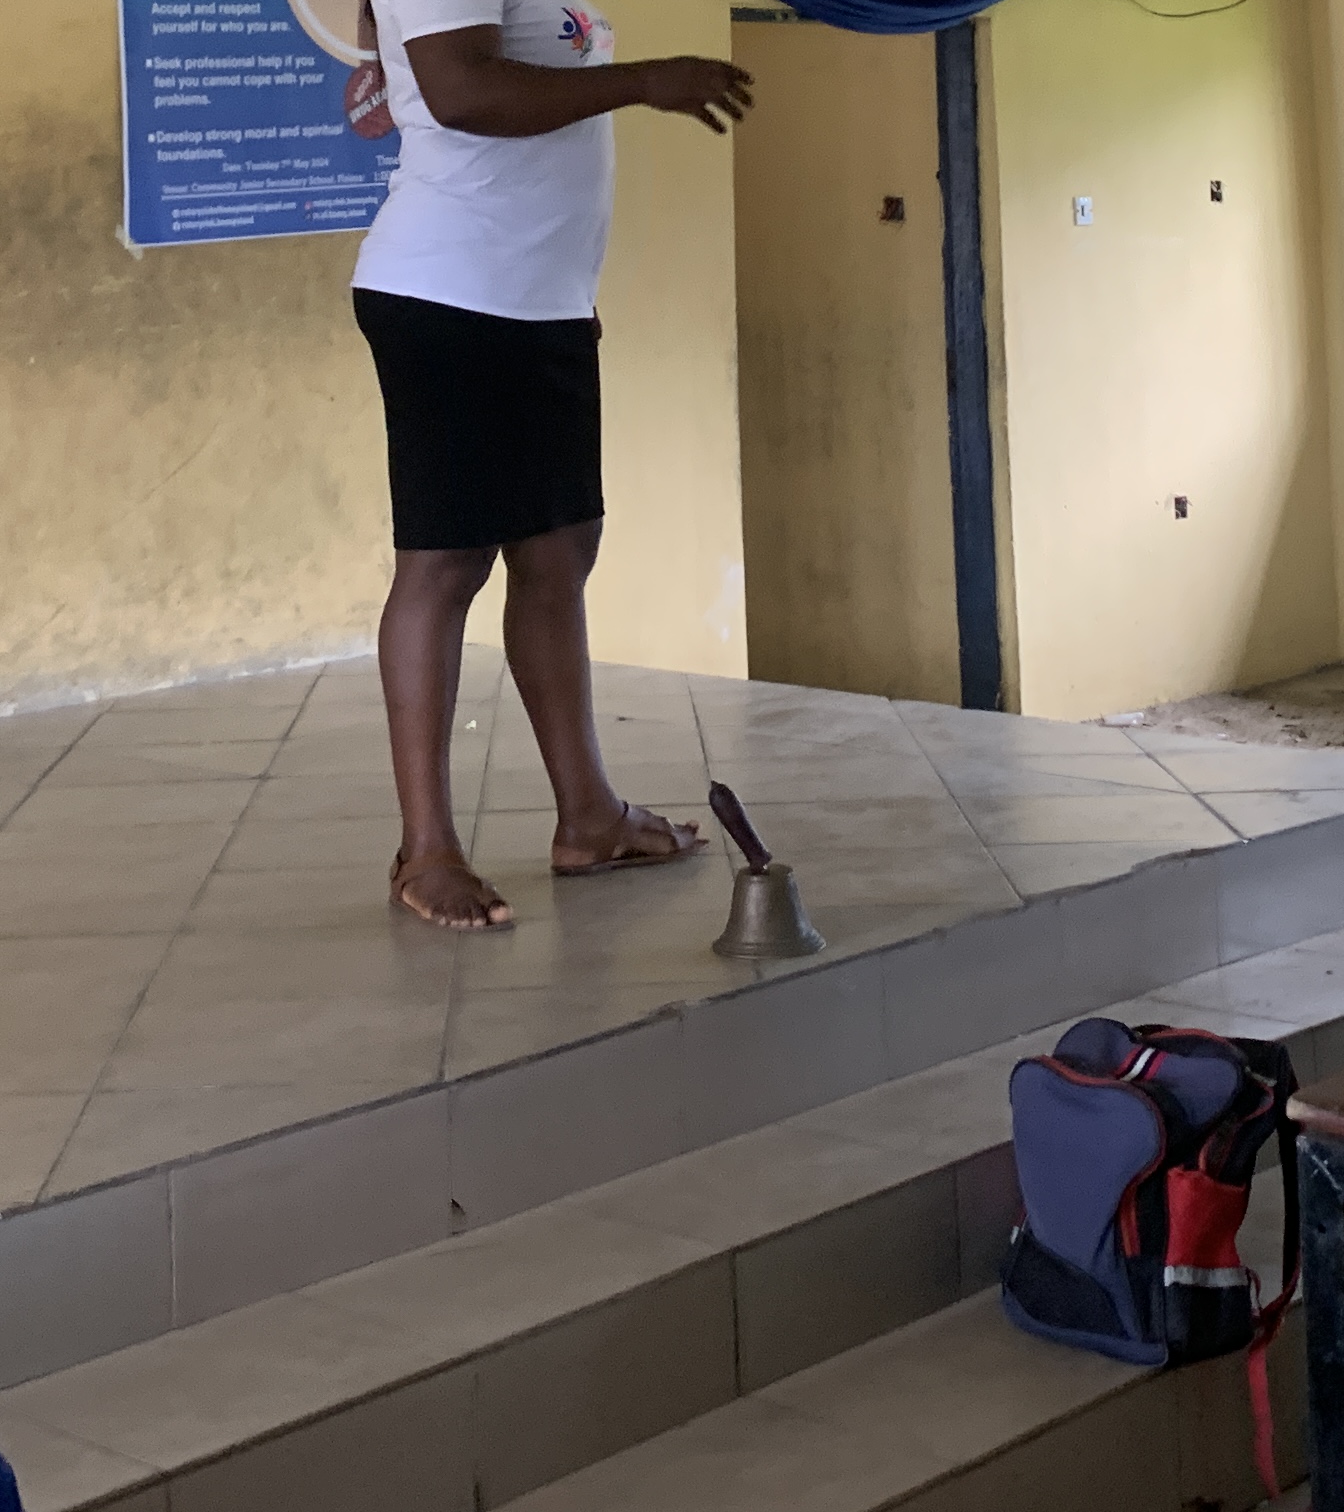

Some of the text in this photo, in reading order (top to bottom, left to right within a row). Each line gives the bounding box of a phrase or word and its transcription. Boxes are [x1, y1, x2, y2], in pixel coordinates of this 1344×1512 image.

[152, 2, 261, 18] Accept and respect
[152, 20, 198, 35] yourself
[201, 20, 217, 33] for
[220, 20, 244, 32] who
[247, 22, 268, 35] you
[154, 57, 182, 69] Seek
[184, 55, 255, 71] professional
[258, 55, 283, 70] help
[295, 56, 315, 70] you
[154, 72, 325, 90] feel you cannot cope with your
[157, 123, 344, 145] Develop strong moral and spiritual
